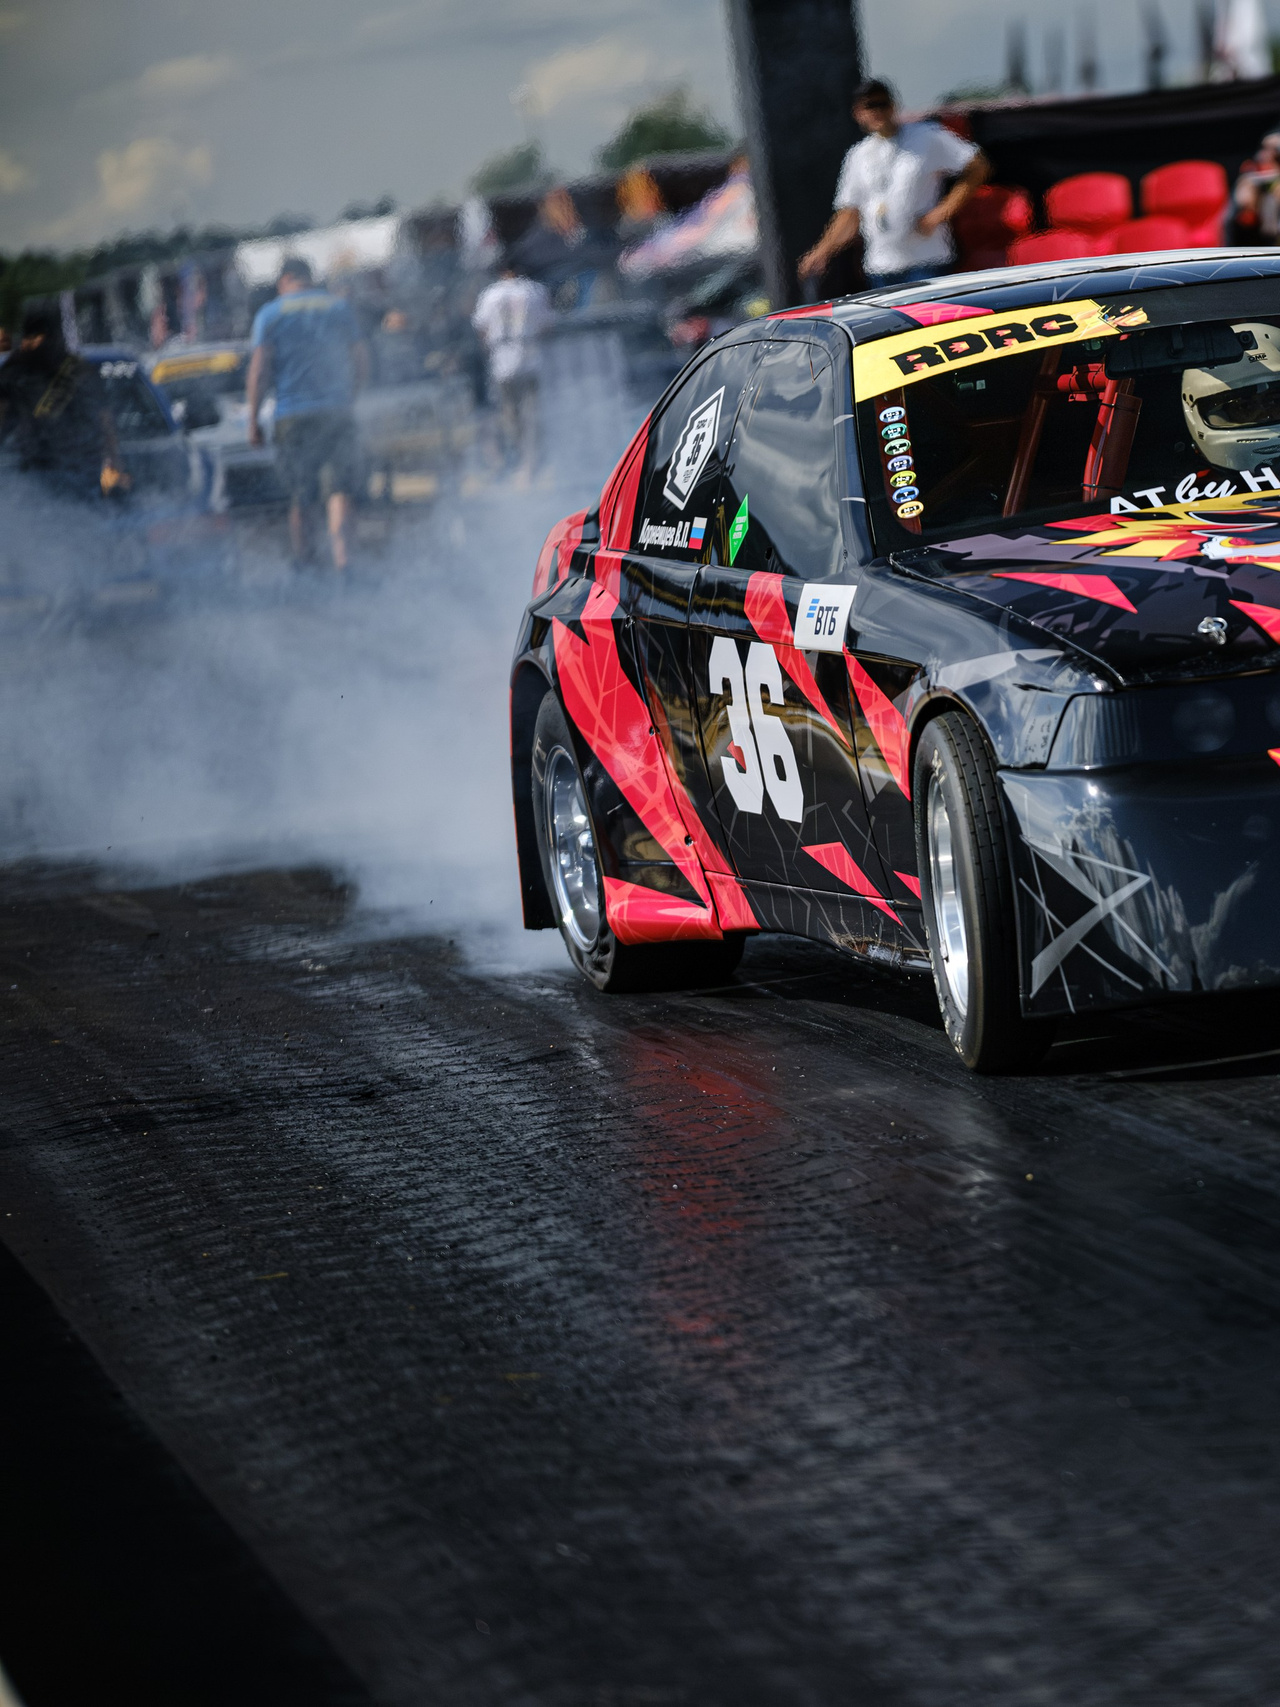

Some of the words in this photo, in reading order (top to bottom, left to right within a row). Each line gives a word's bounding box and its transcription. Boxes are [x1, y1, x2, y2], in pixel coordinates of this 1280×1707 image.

[889, 313, 1079, 376] RDRC
[686, 431, 706, 467] 36
[1175, 473, 1238, 504] by
[814, 606, 839, 636] ВТБ
[708, 636, 804, 824] 36
